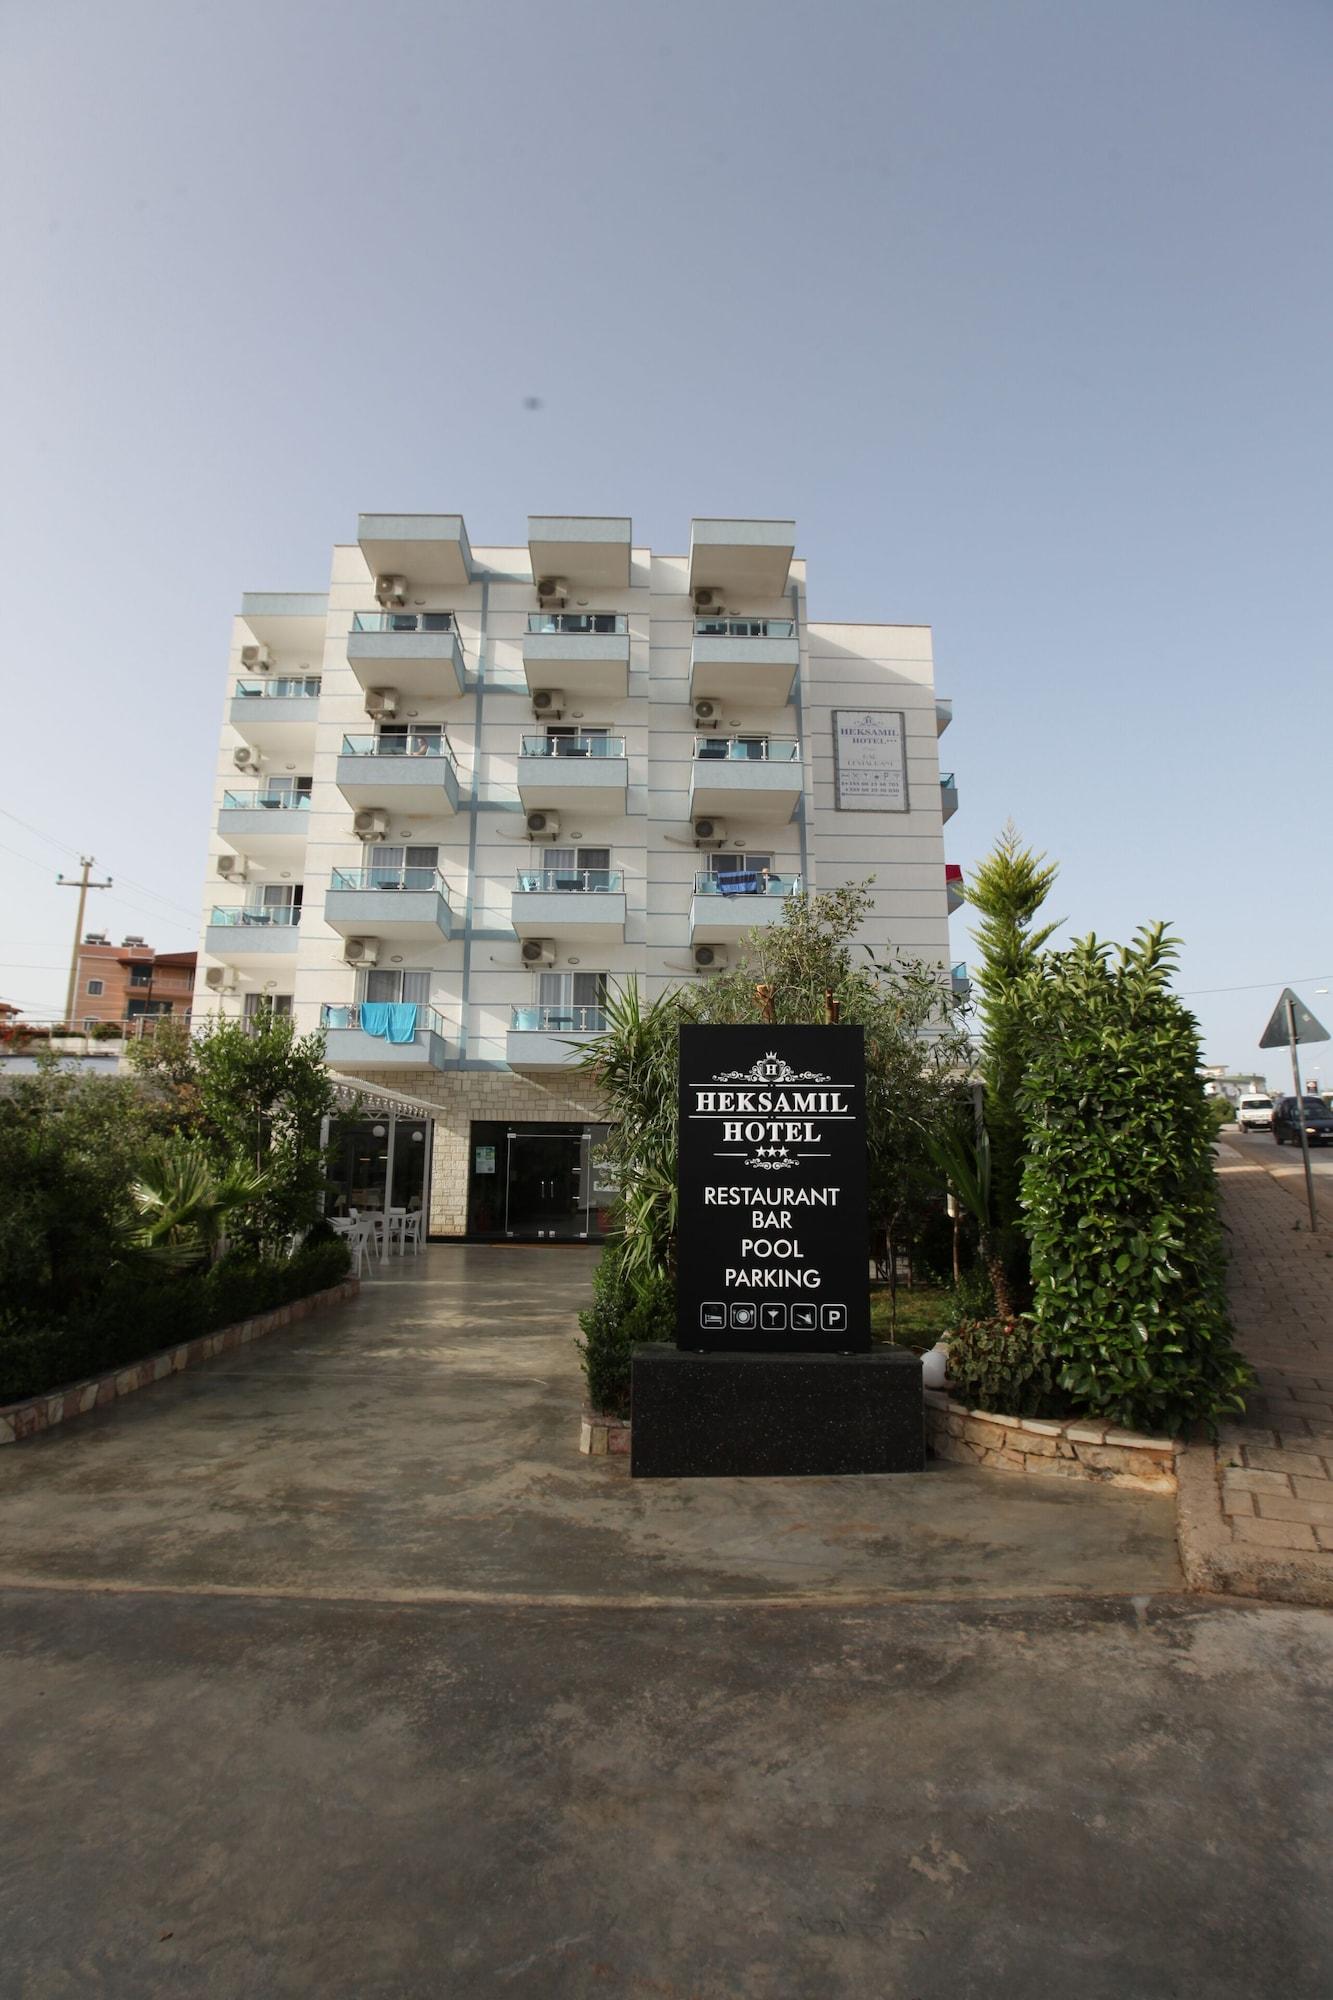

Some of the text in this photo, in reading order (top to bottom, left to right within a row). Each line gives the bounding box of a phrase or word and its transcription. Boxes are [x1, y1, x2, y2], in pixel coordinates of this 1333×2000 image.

[841, 728, 899, 736] HEKSAMIL
[765, 1063, 777, 1075] H
[696, 1092, 848, 1112] HEKSAMIL
[723, 1122, 821, 1142] HOTEL
[705, 1187, 840, 1205] RESTAURANT
[753, 1211, 792, 1228] BAR
[742, 1239, 804, 1258] POOL
[726, 1269, 820, 1288] PARKING
